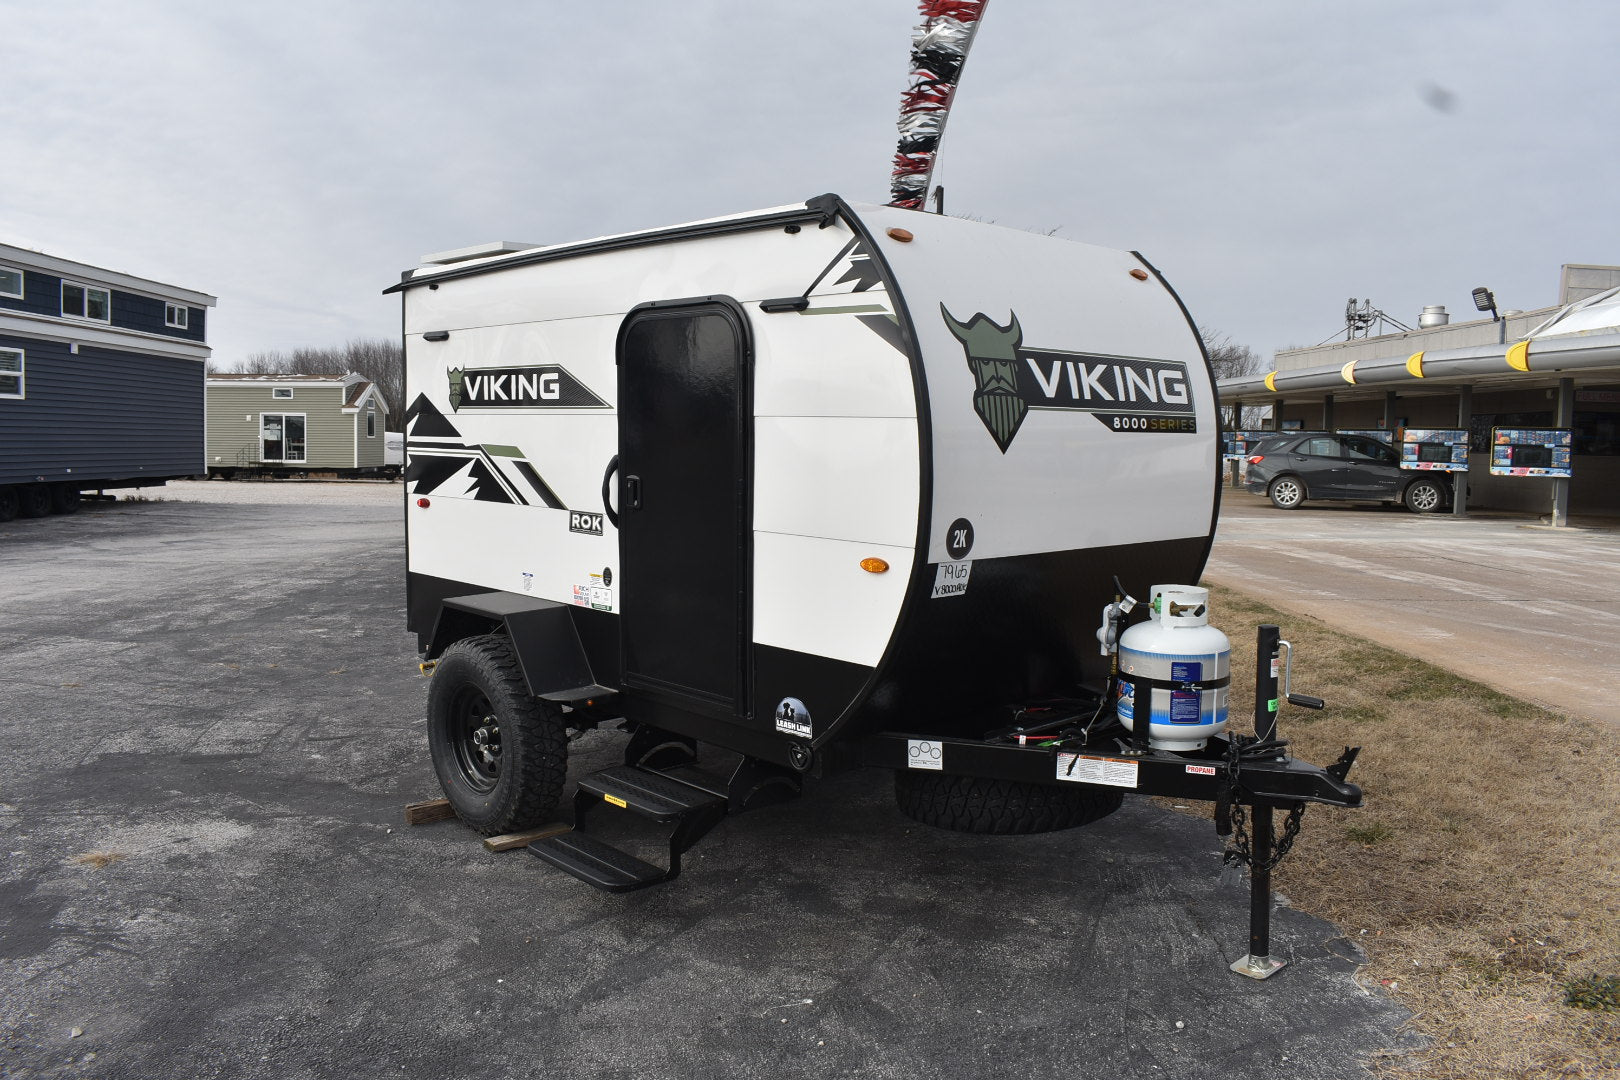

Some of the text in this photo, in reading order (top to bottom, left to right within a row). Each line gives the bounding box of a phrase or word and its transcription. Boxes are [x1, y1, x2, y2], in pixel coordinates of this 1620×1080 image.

[464, 372, 559, 401] VIKING
[1026, 358, 1188, 404] VIKING
[1113, 416, 1196, 431] 8000 SERIES
[571, 513, 602, 531] ROK
[953, 530, 968, 548] 2K
[940, 564, 967, 579] 7965
[776, 719, 811, 733] LEASH LINK
[1187, 766, 1215, 775] PROPANE
